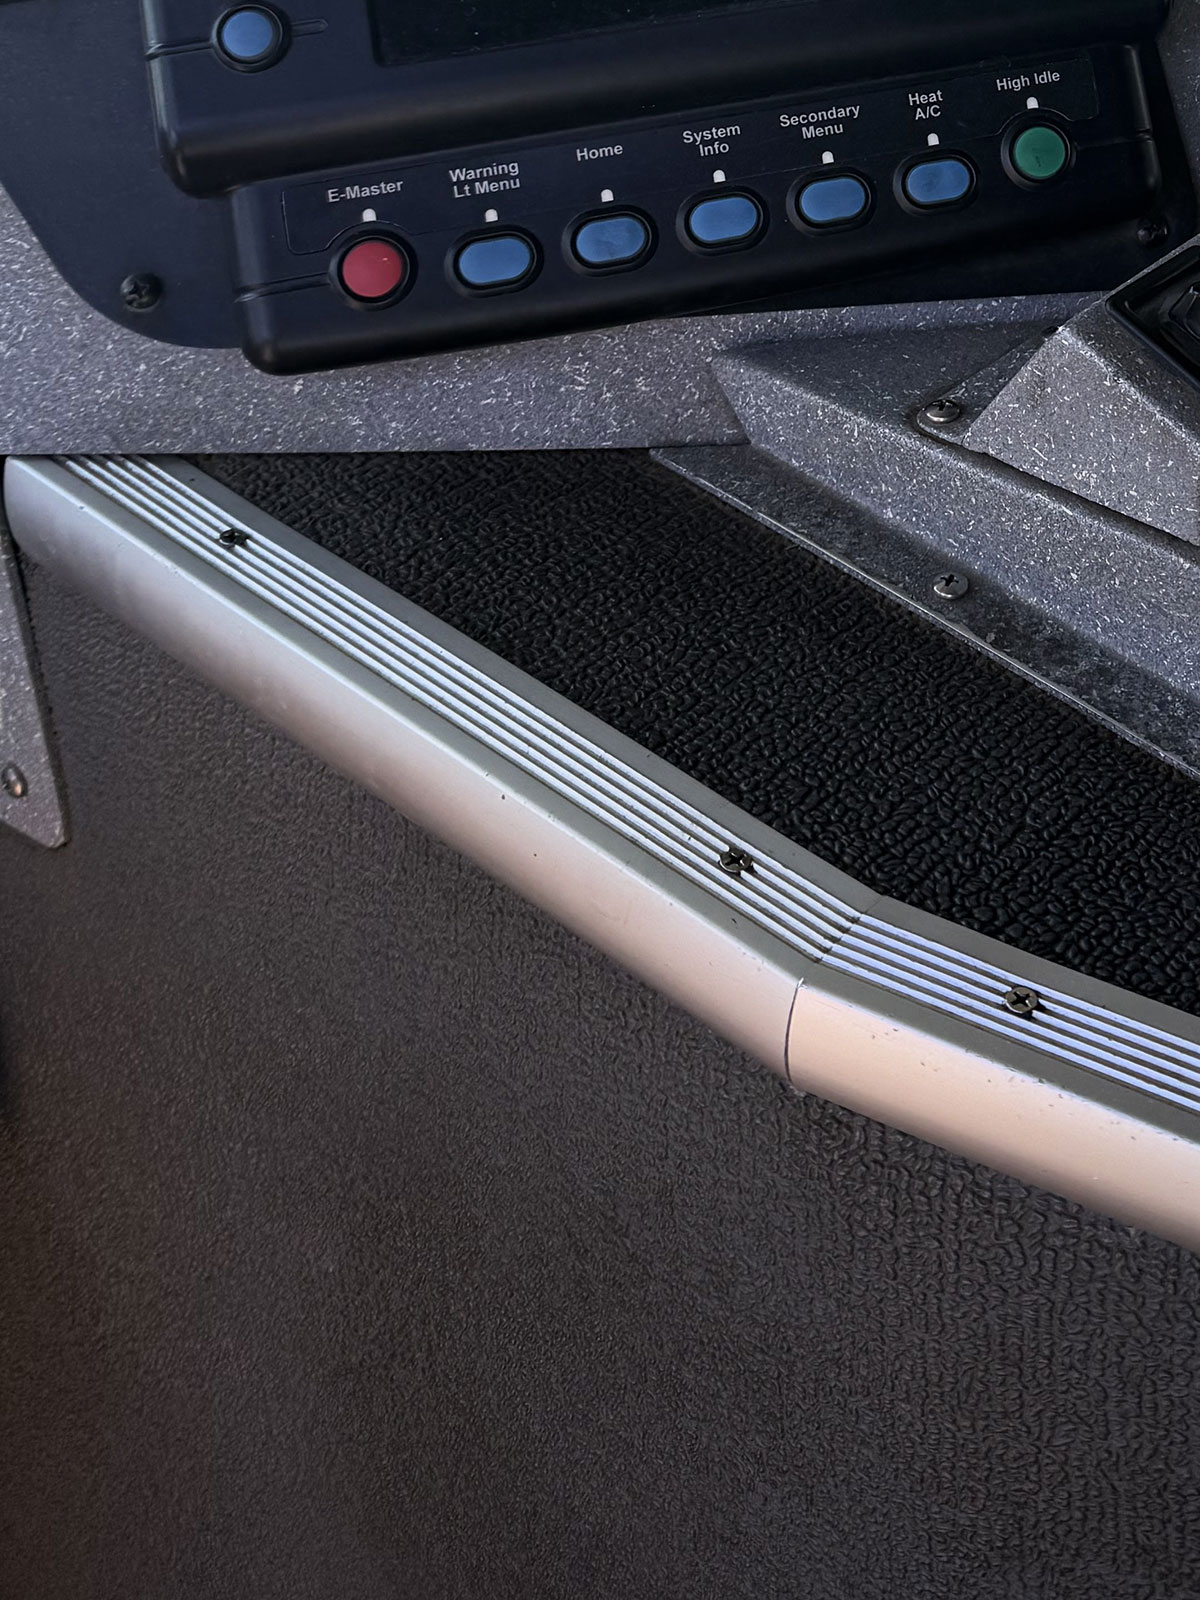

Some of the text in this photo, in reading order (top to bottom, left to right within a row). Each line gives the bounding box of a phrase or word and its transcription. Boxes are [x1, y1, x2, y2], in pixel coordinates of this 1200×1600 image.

[996, 69, 1061, 93] High Idle
[908, 89, 944, 107] Heat
[778, 104, 861, 128] Secondary
[914, 104, 942, 121] A/C
[682, 123, 742, 146] System
[801, 121, 845, 140] Menu
[575, 143, 624, 162] Home
[698, 141, 731, 157] Info
[449, 162, 520, 182] Warning
[327, 179, 404, 203] E-Master
[453, 176, 521, 199] Lt Menu
